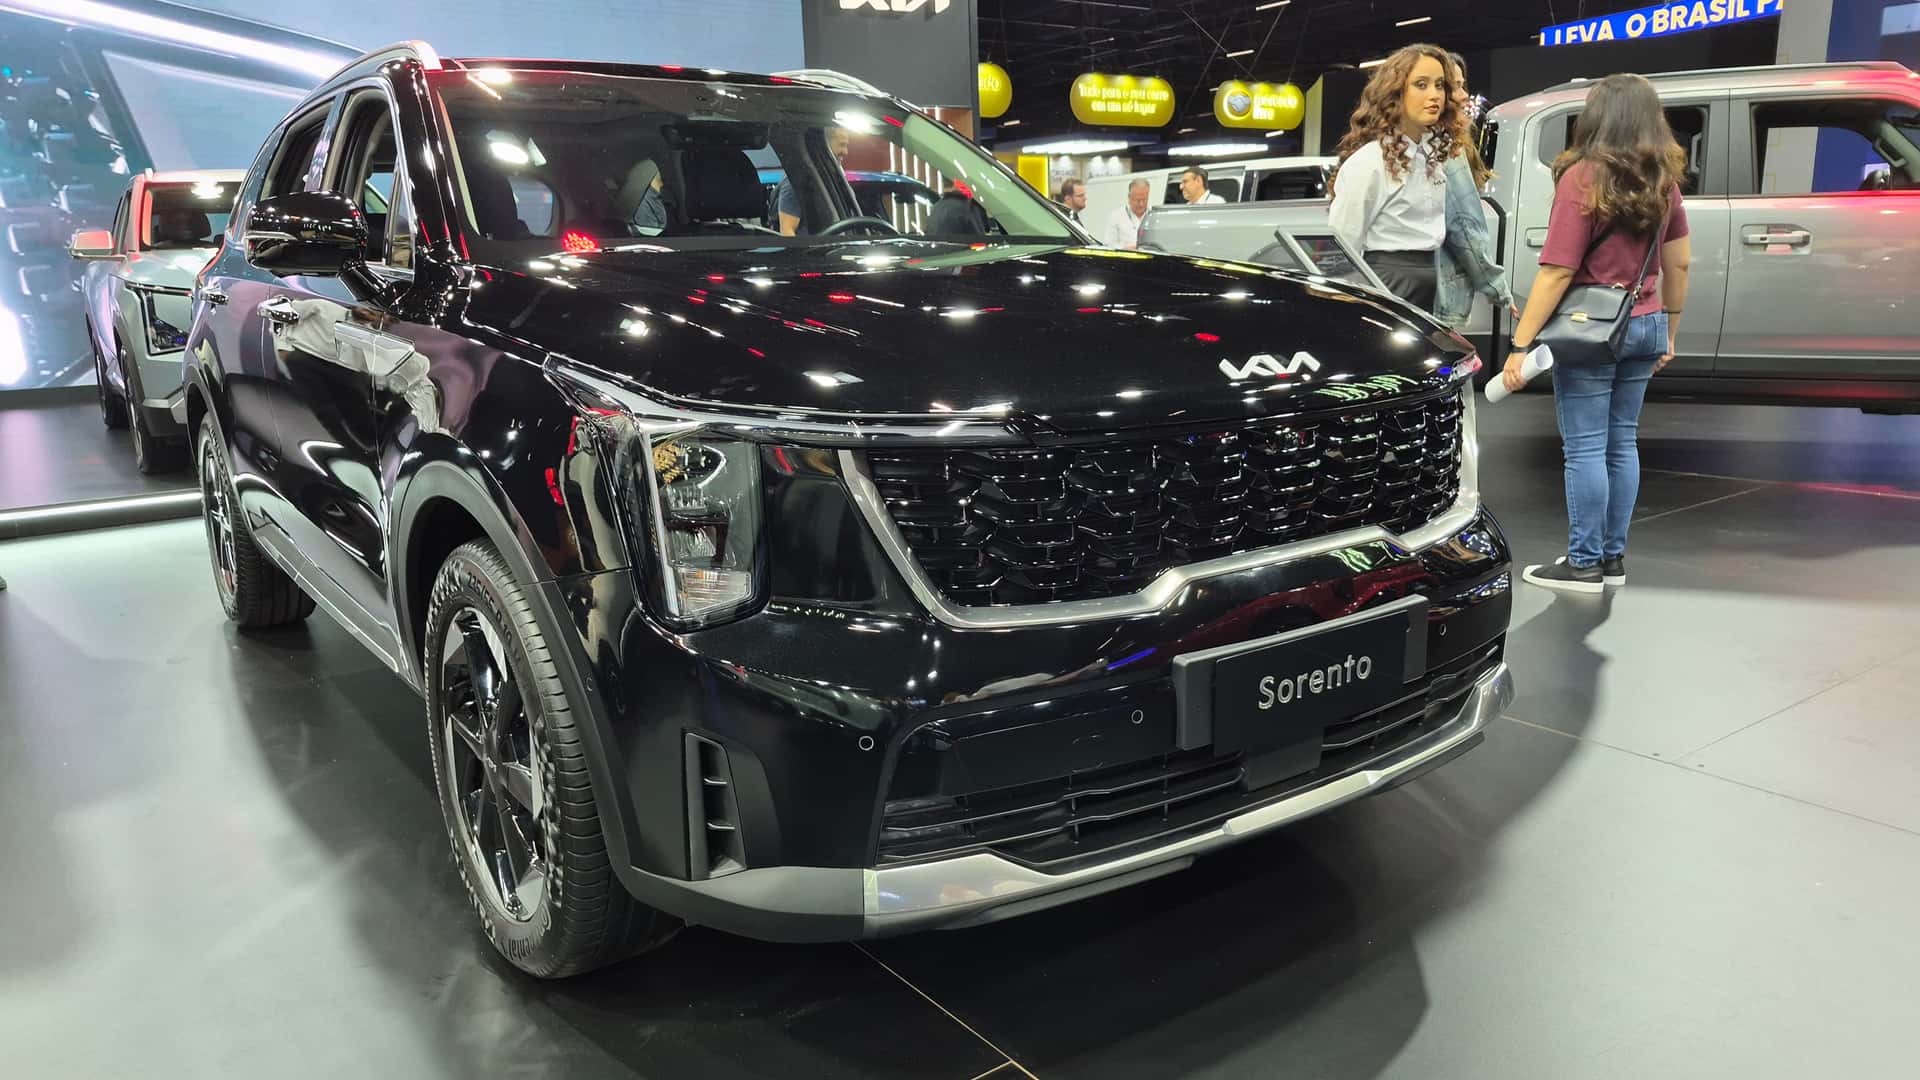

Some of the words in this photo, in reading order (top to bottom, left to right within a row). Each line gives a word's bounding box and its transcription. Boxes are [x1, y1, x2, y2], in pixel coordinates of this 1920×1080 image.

[1625, 13, 1647, 38] O
[1652, 0, 1751, 34] BRASIL
[1218, 351, 1321, 380] KIA
[1258, 653, 1373, 710] Sorento
